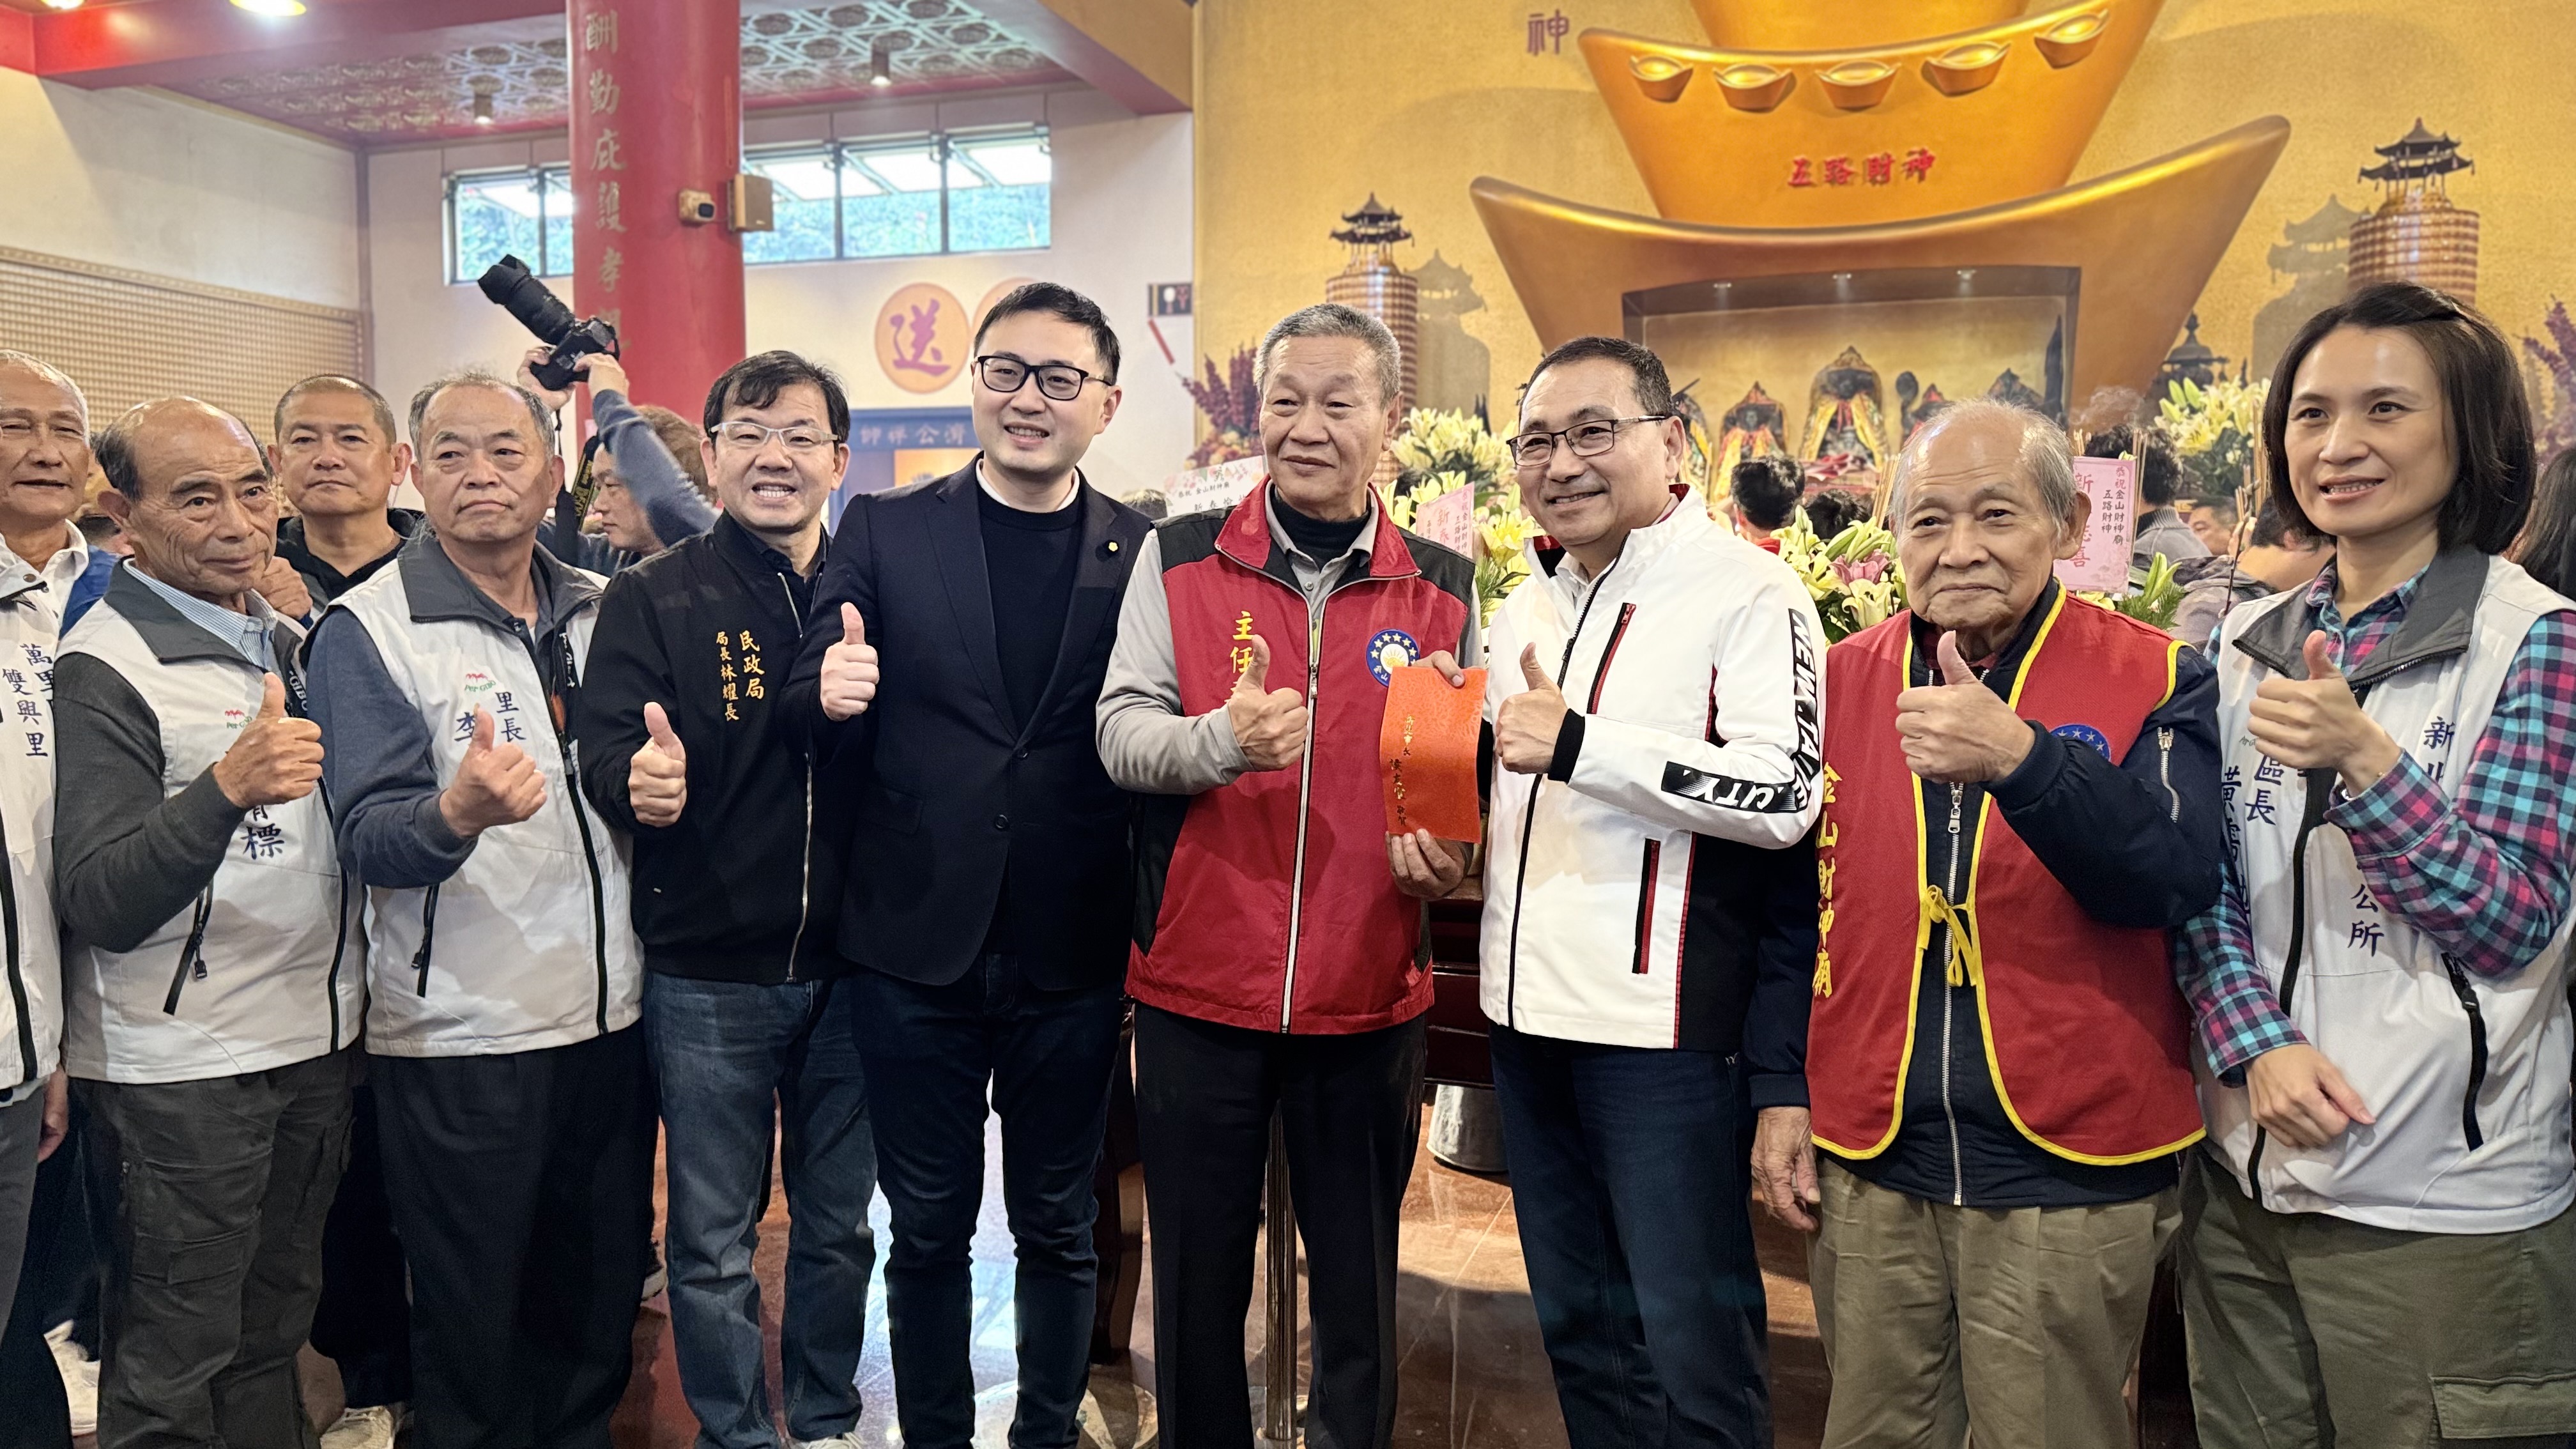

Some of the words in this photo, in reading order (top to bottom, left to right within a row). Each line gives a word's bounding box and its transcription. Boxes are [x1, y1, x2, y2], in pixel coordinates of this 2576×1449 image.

[1788, 148, 1936, 187] 五路財神
[889, 298, 951, 378] 送
[2101, 489, 2113, 533] 五路財神
[20, 643, 54, 707] 萬里
[716, 631, 740, 722] 局長林耀長
[739, 630, 765, 700] 民政局
[2, 668, 48, 757] 雙興里
[494, 691, 527, 742] 里長
[2244, 755, 2285, 825] 區長
[1812, 762, 1843, 999] 金山財神廟
[2347, 884, 2385, 957] 公所
